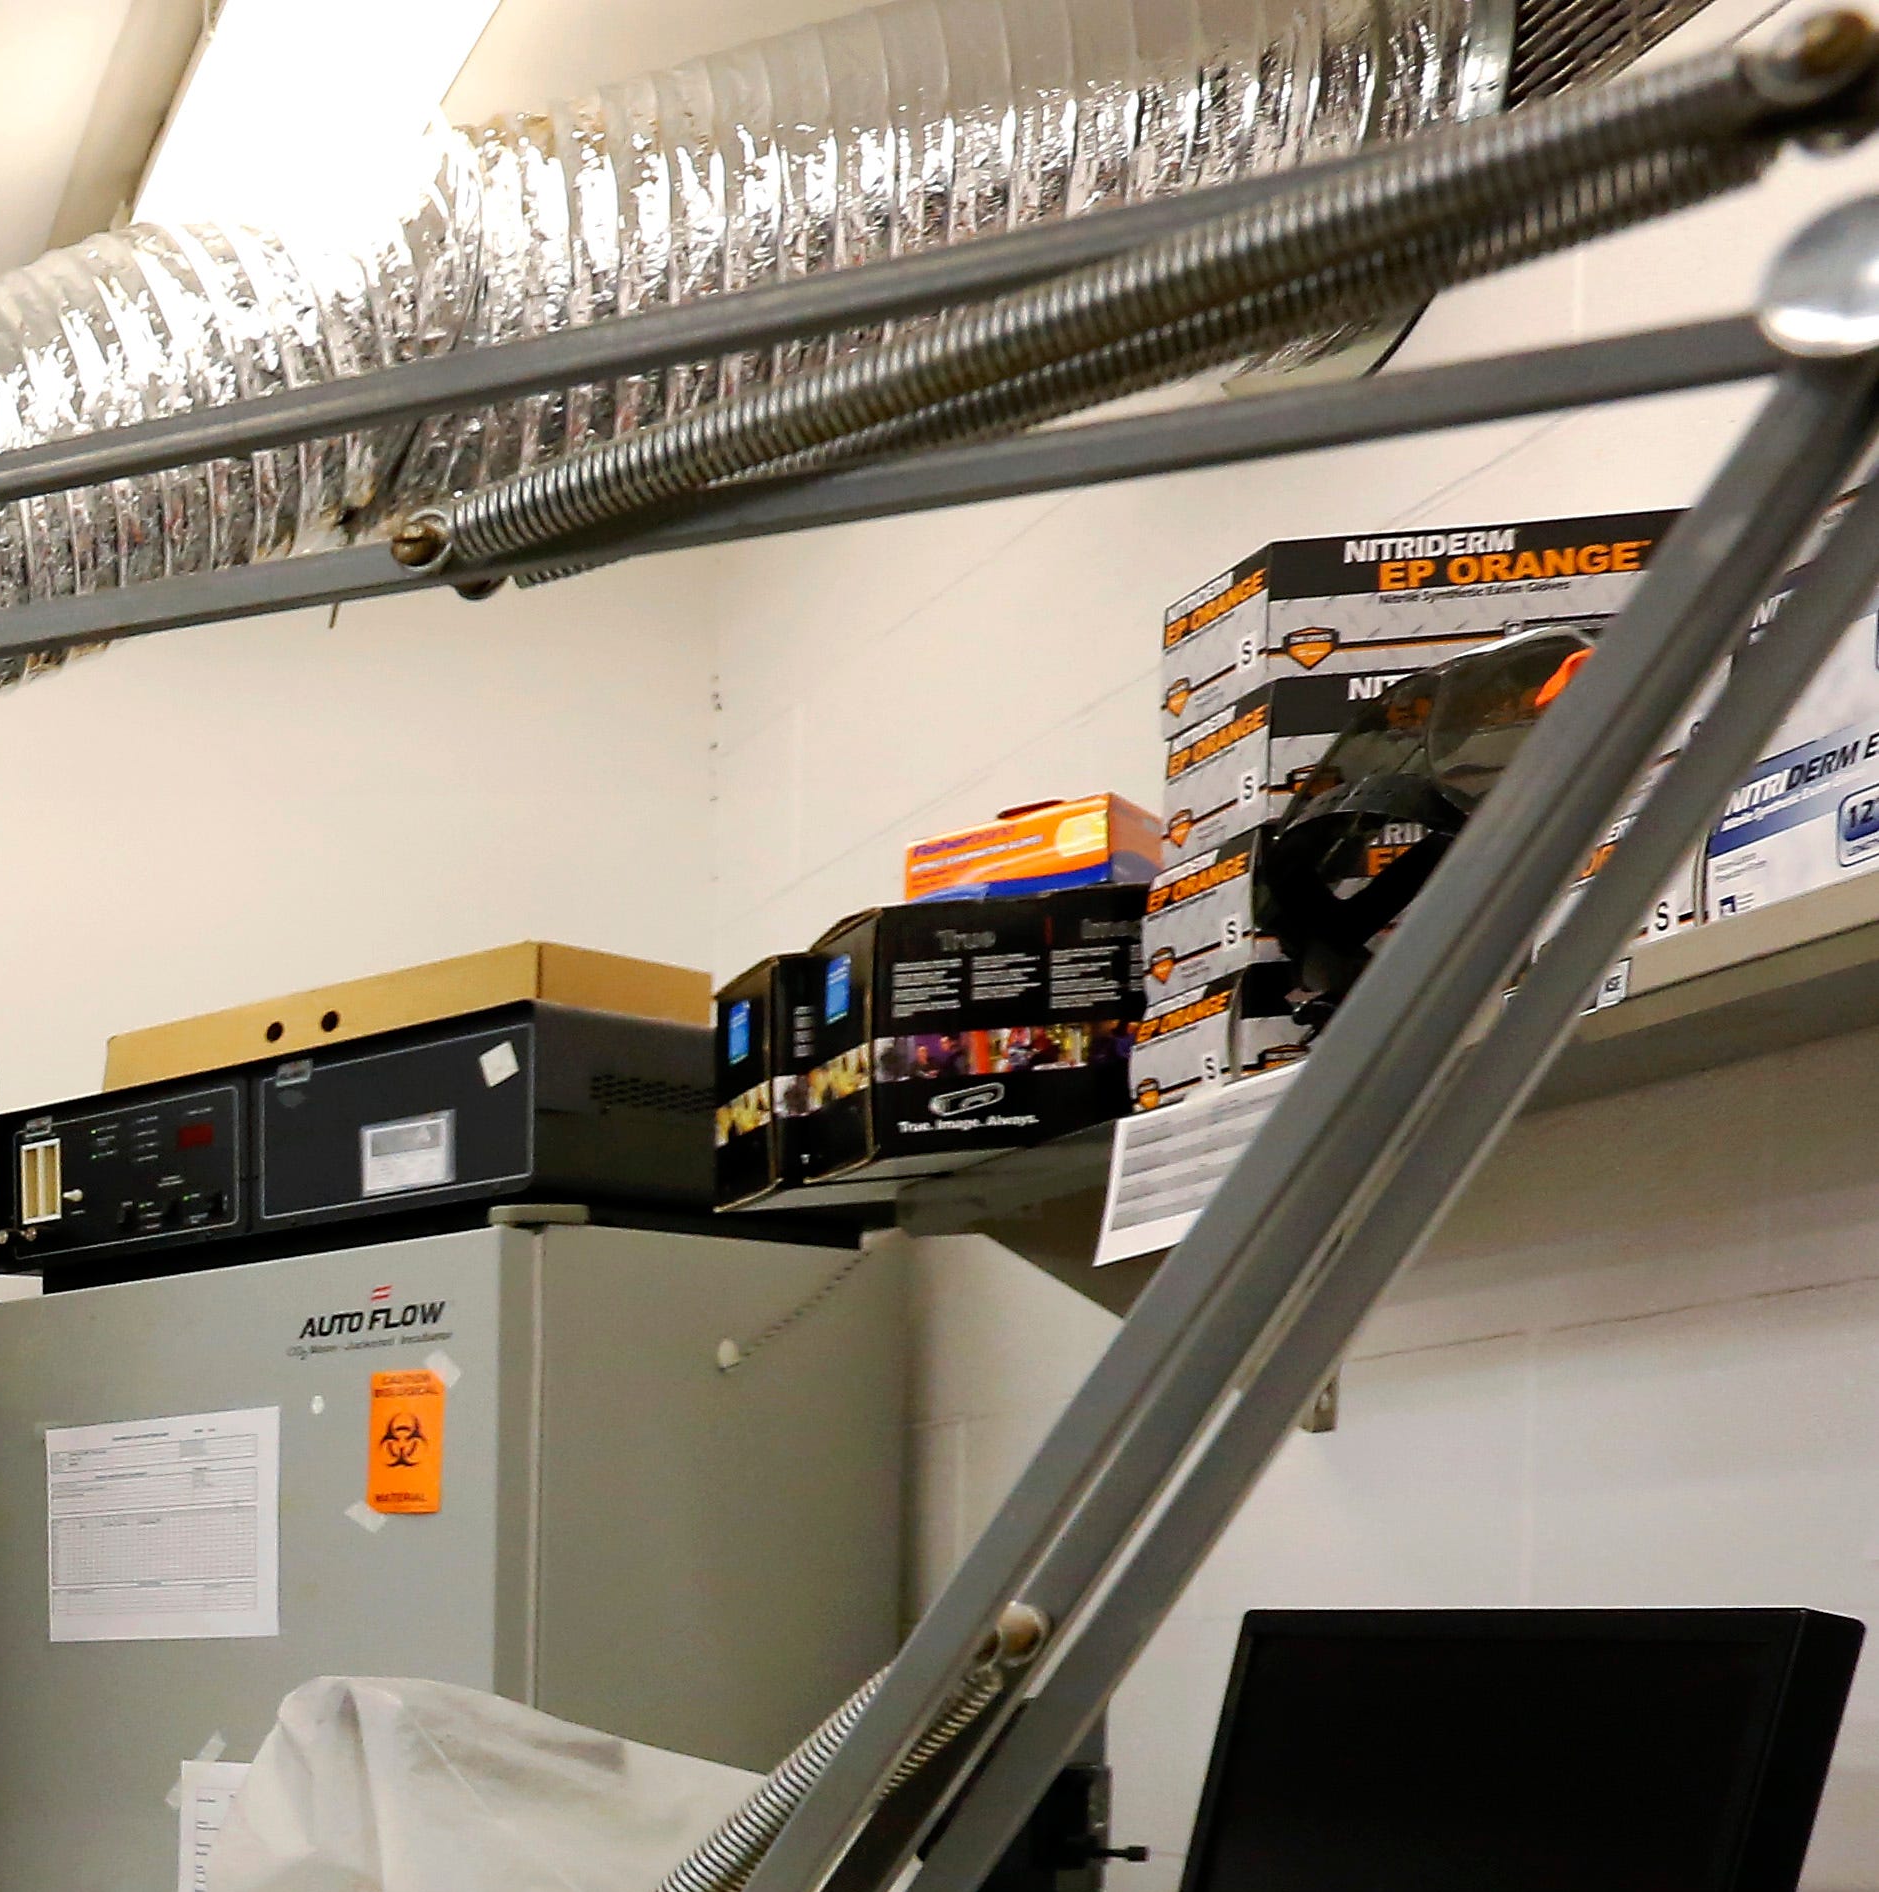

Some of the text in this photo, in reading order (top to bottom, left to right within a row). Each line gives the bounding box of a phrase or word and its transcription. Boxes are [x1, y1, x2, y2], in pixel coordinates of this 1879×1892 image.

[1344, 528, 1517, 564] NITRIDERM
[1379, 559, 1436, 592] EP
[1241, 640, 1252, 665] S
[1243, 775, 1255, 800] S
[1726, 739, 1860, 816] NITRIDERM
[1226, 919, 1238, 945] S
[1655, 901, 1669, 932] S
[1205, 1056, 1217, 1081] S
[299, 1300, 447, 1339] AUTO FLOW
